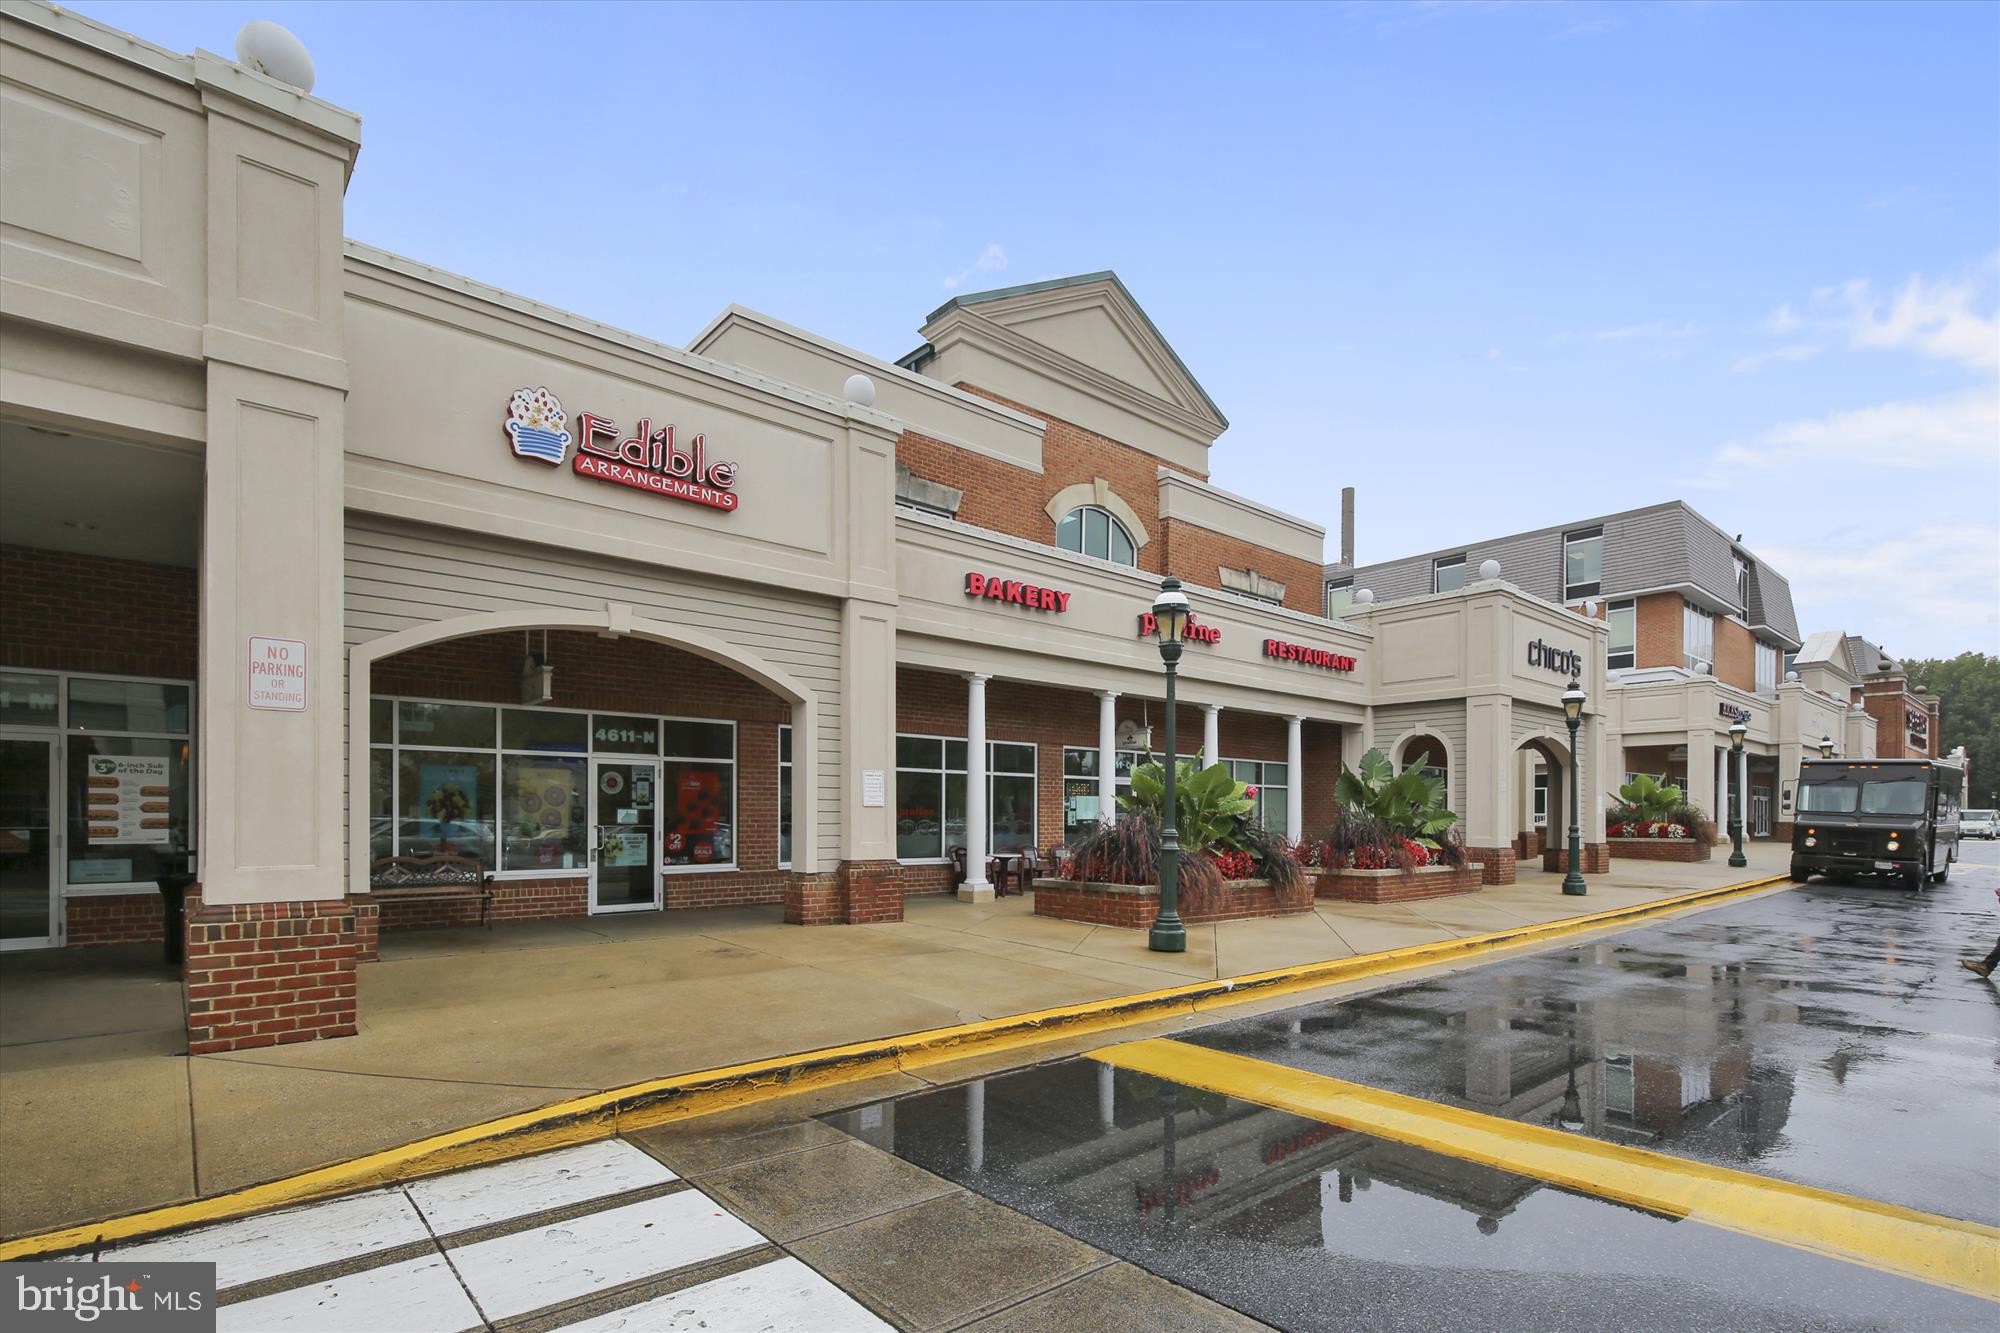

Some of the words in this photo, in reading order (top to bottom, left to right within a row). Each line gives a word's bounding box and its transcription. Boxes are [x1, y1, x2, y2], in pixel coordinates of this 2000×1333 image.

[580, 457, 733, 506] ARRANGEMENTS
[965, 572, 1071, 613] BAKERY
[267, 646, 289, 660] NO
[1262, 639, 1357, 672] RESTAURANT
[1528, 638, 1581, 678] chico's
[252, 661, 303, 678] PARKING
[271, 679, 285, 688] OR
[254, 690, 302, 702] STANDING
[595, 728, 655, 744] 4611-N
